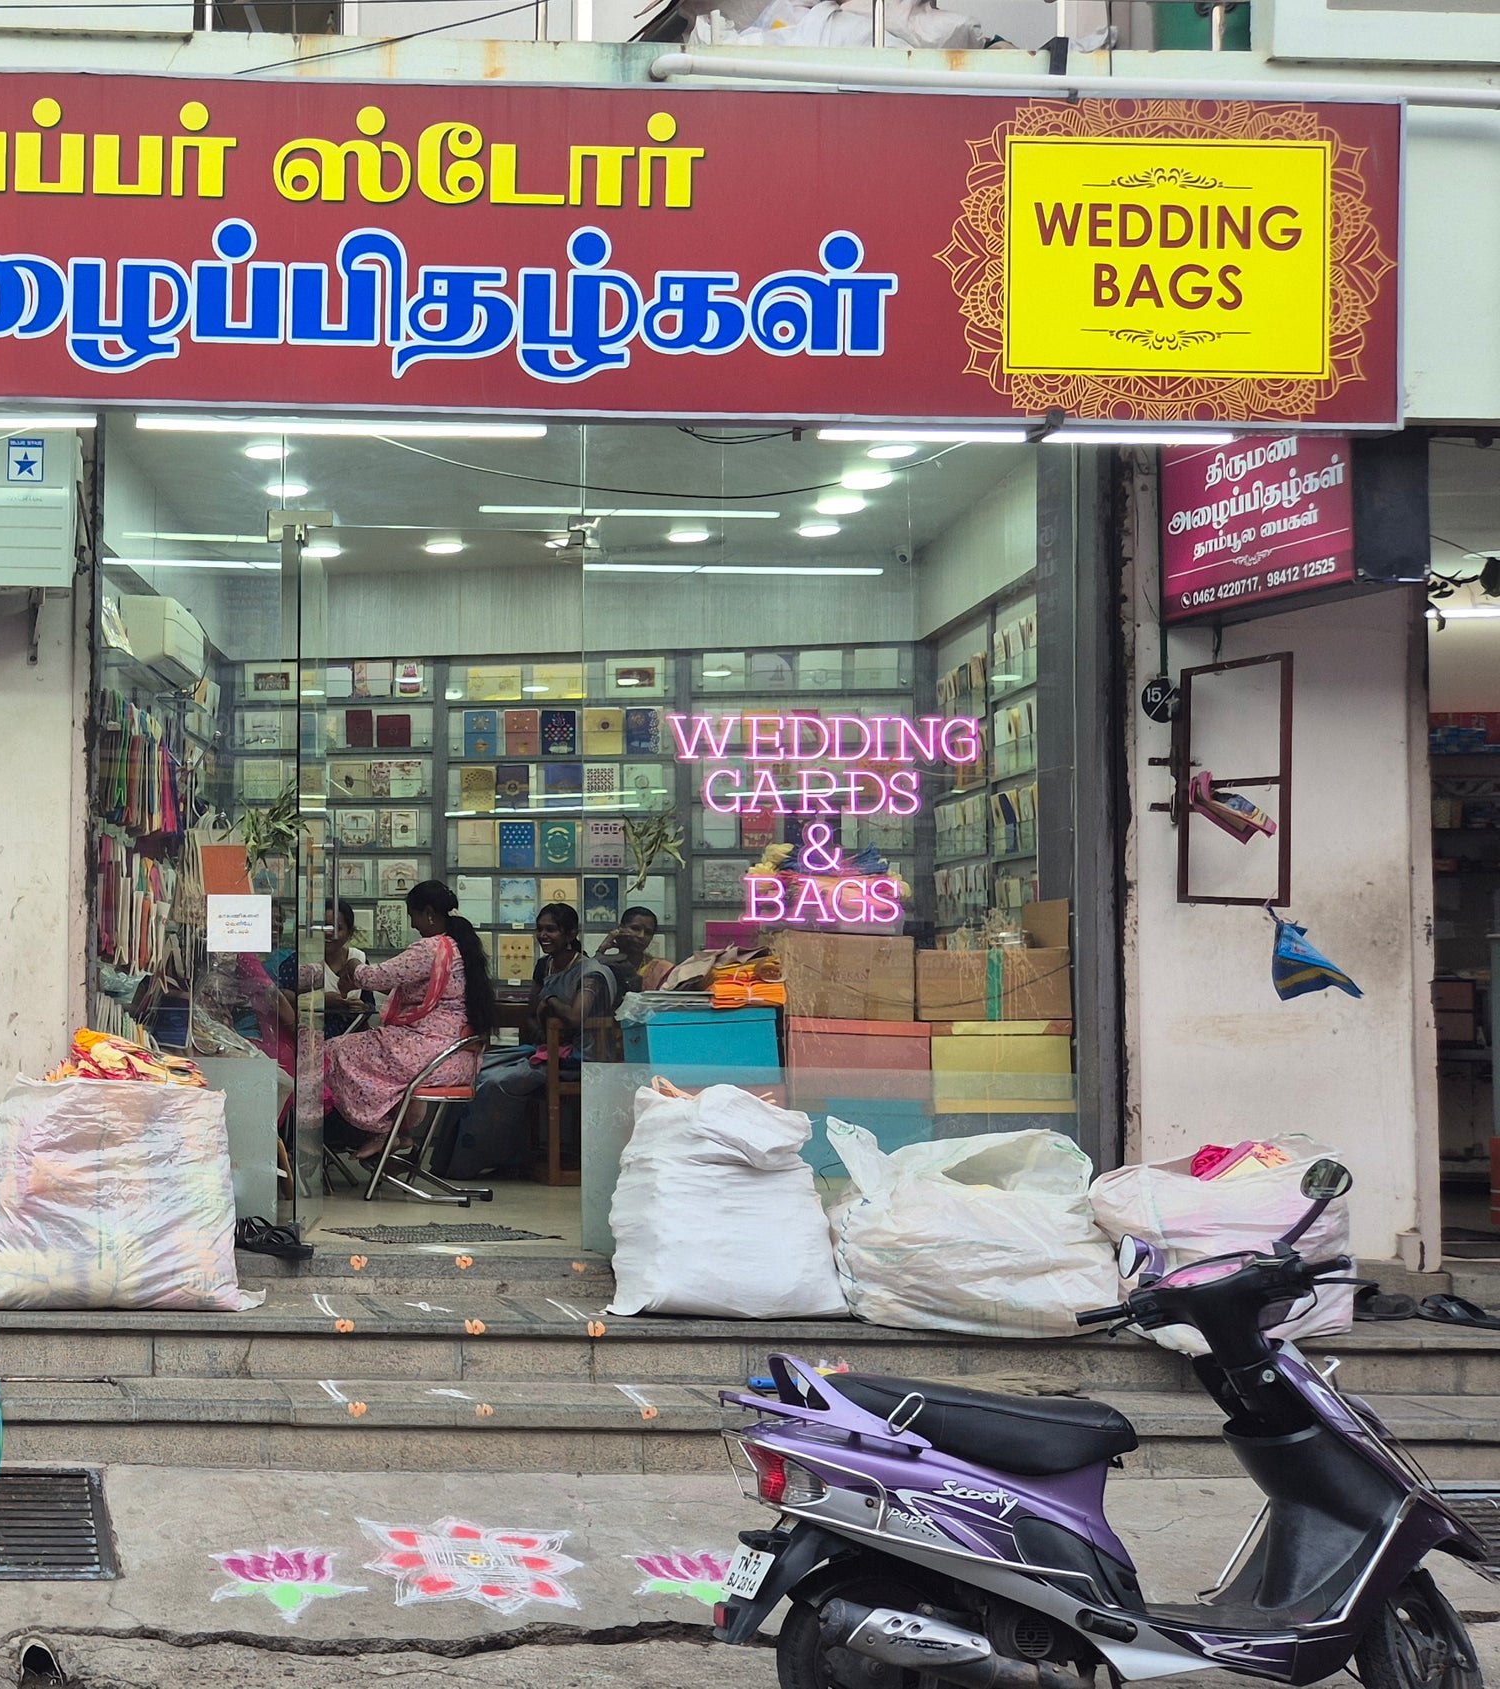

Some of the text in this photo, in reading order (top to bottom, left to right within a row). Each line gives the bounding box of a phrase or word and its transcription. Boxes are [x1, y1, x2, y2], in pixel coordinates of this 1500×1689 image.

[273, 105, 705, 208] ஸ்டோர்
[1034, 201, 1302, 251] WEDDING
[1093, 263, 1244, 310] BAGS
[1205, 436, 1298, 491] திருமண
[1168, 454, 1345, 535] அழைப்பிதழ்கள்
[1193, 503, 1319, 561] தாம்பூல பைகள்
[1193, 557, 1336, 606] 0462 4220717, 98412 12525
[1146, 687, 1161, 702] 15
[666, 714, 980, 763] WEDDING
[802, 822, 842, 872] &
[741, 876, 901, 924] BAGS
[932, 1481, 1019, 1519] Scooty
[727, 1572, 740, 1587] BJ
[738, 1556, 761, 1574] TN 72
